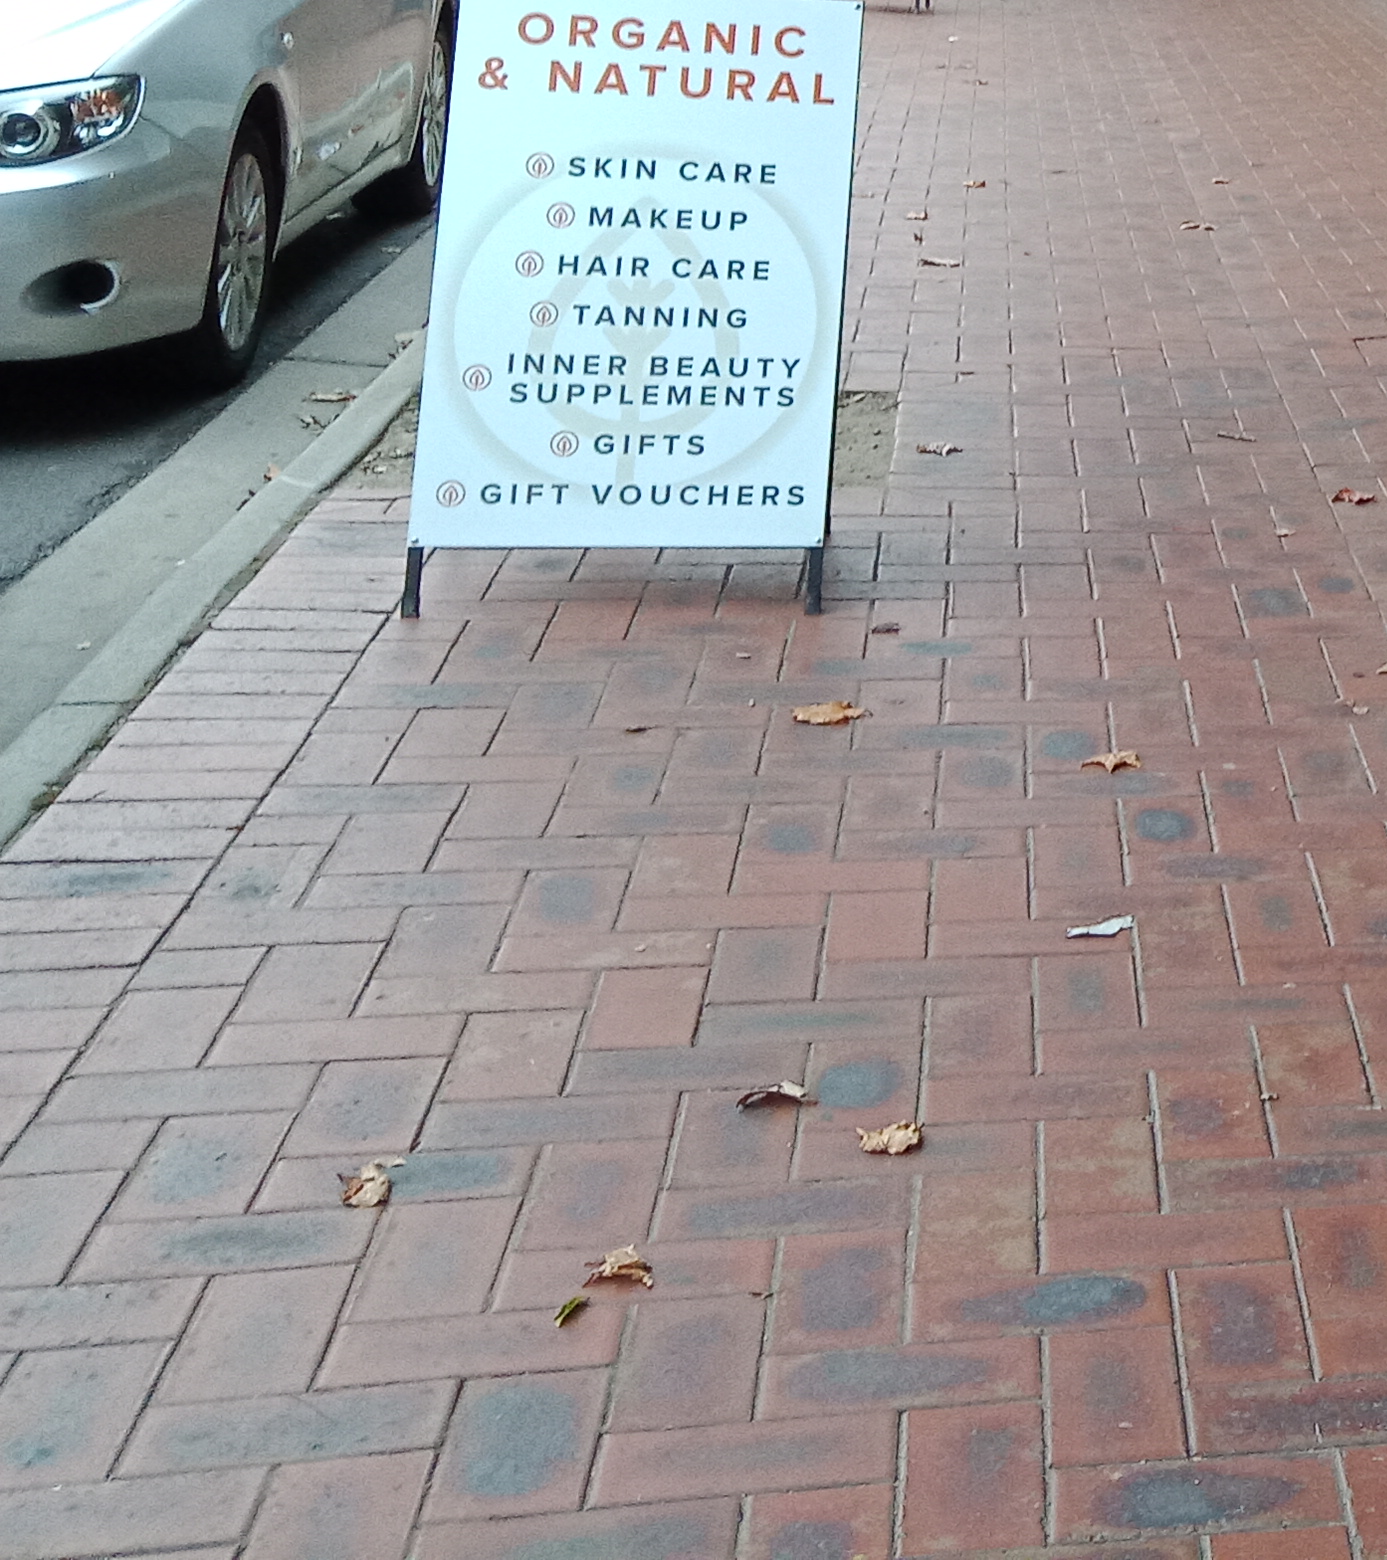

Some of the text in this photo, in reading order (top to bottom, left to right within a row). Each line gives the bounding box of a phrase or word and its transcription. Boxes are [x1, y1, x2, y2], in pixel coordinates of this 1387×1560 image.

[518, 12, 808, 59] ORGANIC
[478, 57, 835, 106] & NATURAL
[568, 156, 777, 185] SKIN CARE
[589, 206, 748, 231] MAKEUP
[558, 256, 770, 281] HAIR CARE
[574, 305, 748, 329] TANNING
[507, 354, 800, 378] INNER BEAUTY
[509, 383, 796, 408] SUPPLEMENTS
[593, 434, 706, 457] GIFTS
[480, 483, 806, 507] GIFT VOUCHERS
